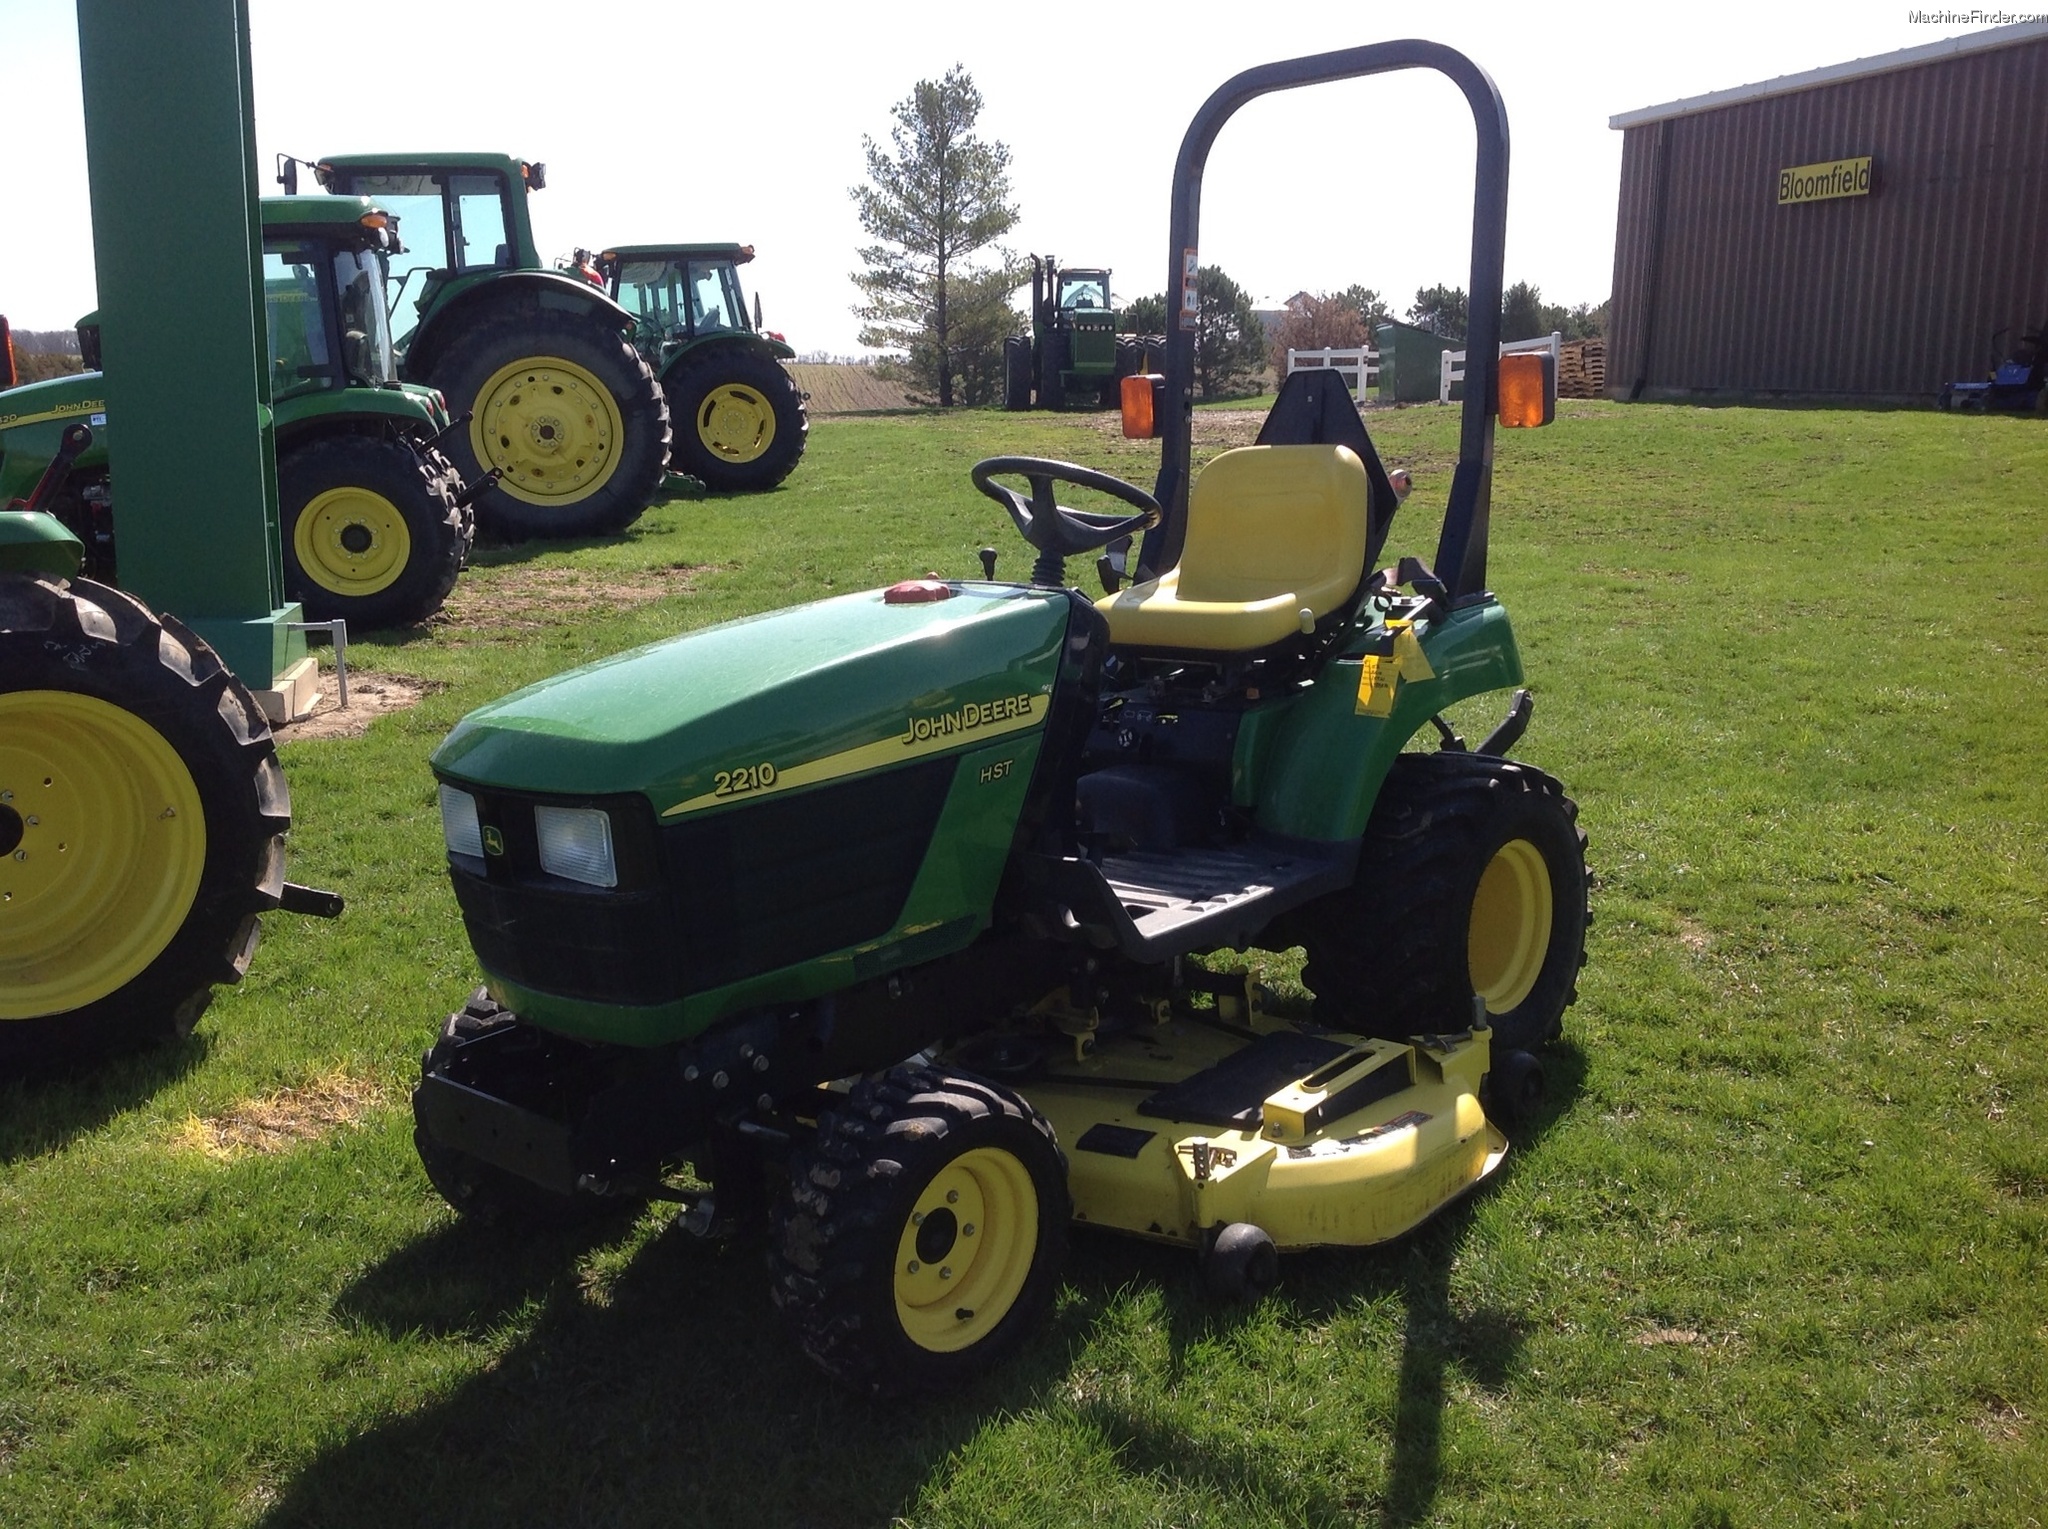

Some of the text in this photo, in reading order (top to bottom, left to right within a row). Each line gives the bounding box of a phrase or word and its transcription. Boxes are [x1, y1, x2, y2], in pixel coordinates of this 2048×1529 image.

[1780, 160, 1870, 201] Bloomfield
[714, 762, 777, 797] 2210
[980, 760, 1013, 784] HST
